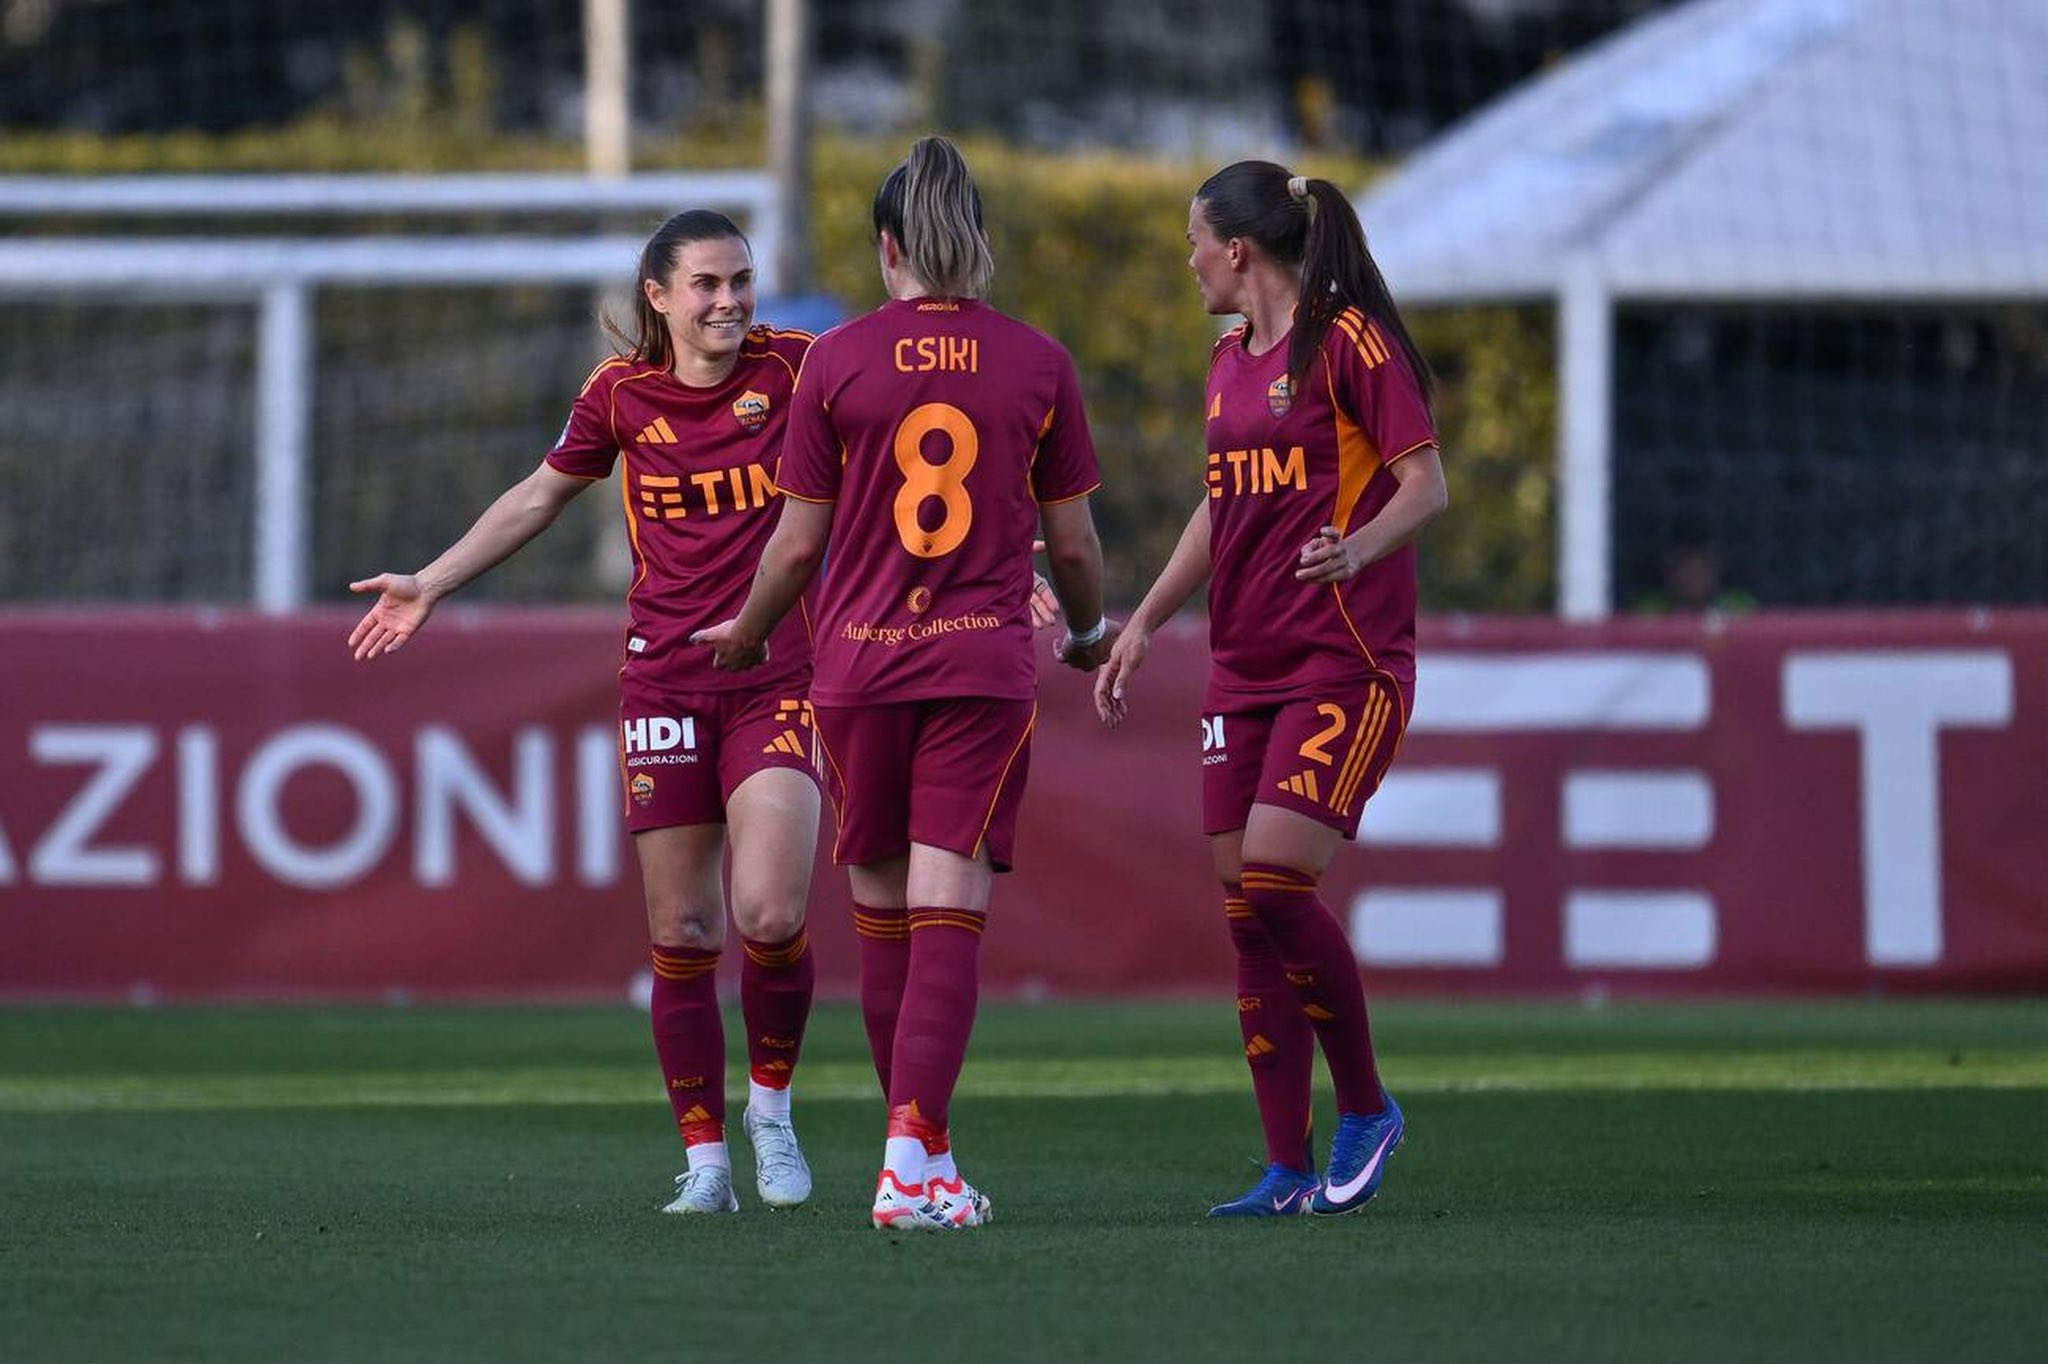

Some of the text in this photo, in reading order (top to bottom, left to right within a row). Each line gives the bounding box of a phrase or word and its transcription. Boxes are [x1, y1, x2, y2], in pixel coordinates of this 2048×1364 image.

[894, 336, 978, 374] CSIKI
[894, 402, 978, 559] 8
[1226, 446, 1307, 496] TIM
[841, 613, 1000, 647] Auberge Collection
[624, 716, 696, 753] HDI
[1299, 703, 1347, 767] 2
[0, 722, 621, 889] ZIONI
